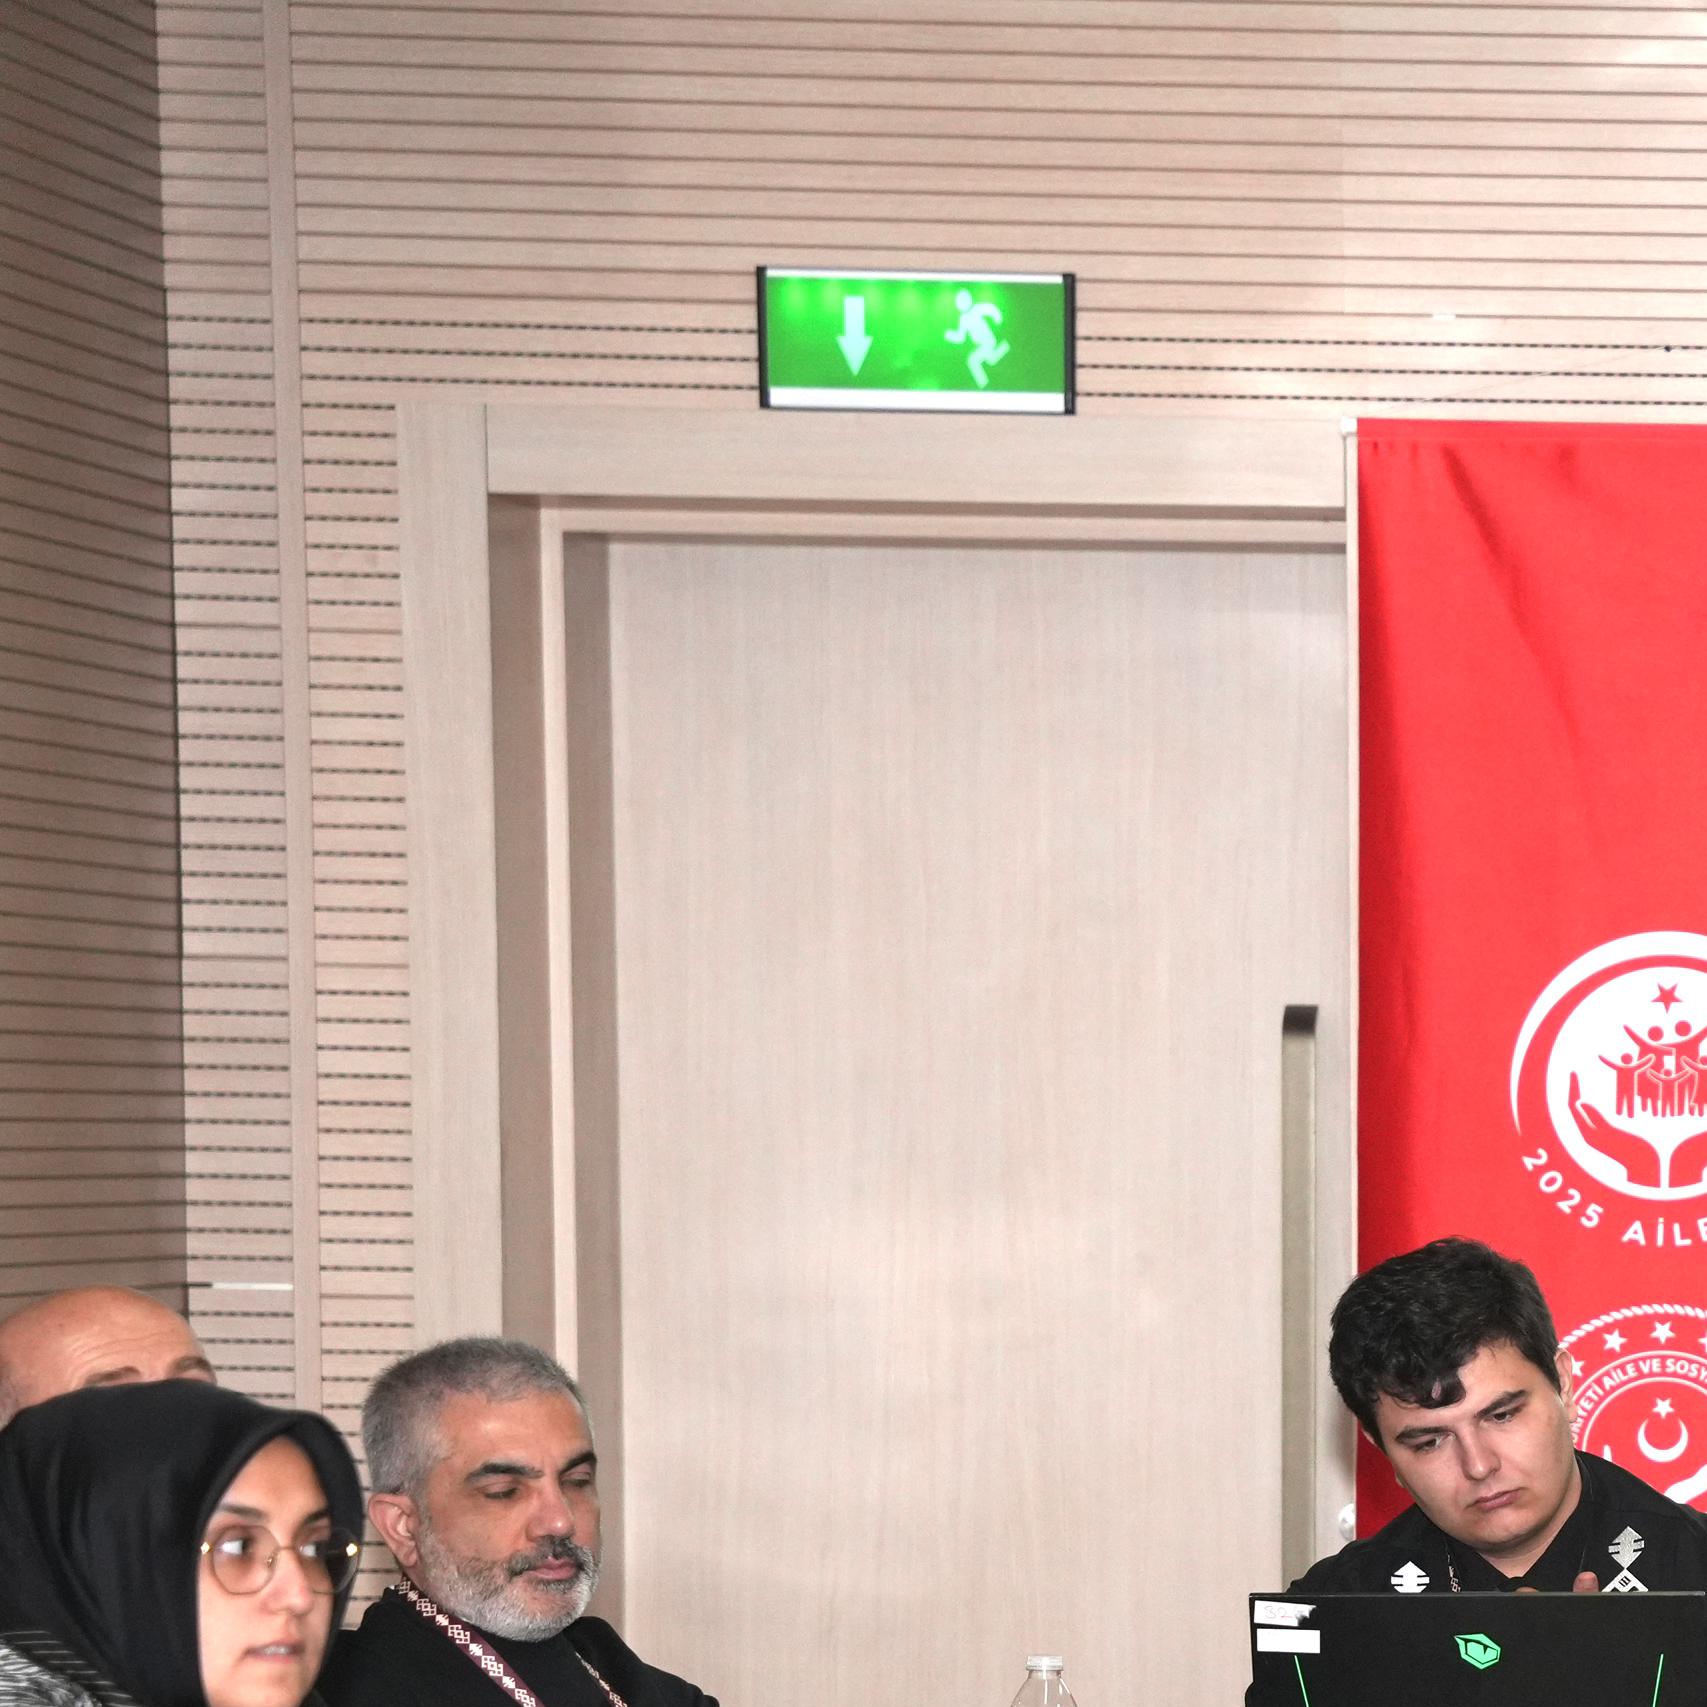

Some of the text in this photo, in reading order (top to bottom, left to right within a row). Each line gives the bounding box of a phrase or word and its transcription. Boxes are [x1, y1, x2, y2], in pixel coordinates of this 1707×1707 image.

[1521, 1148, 1604, 1229] 2025
[1603, 1364, 1639, 1390] AİLE
[1638, 1358, 1663, 1374] VE
